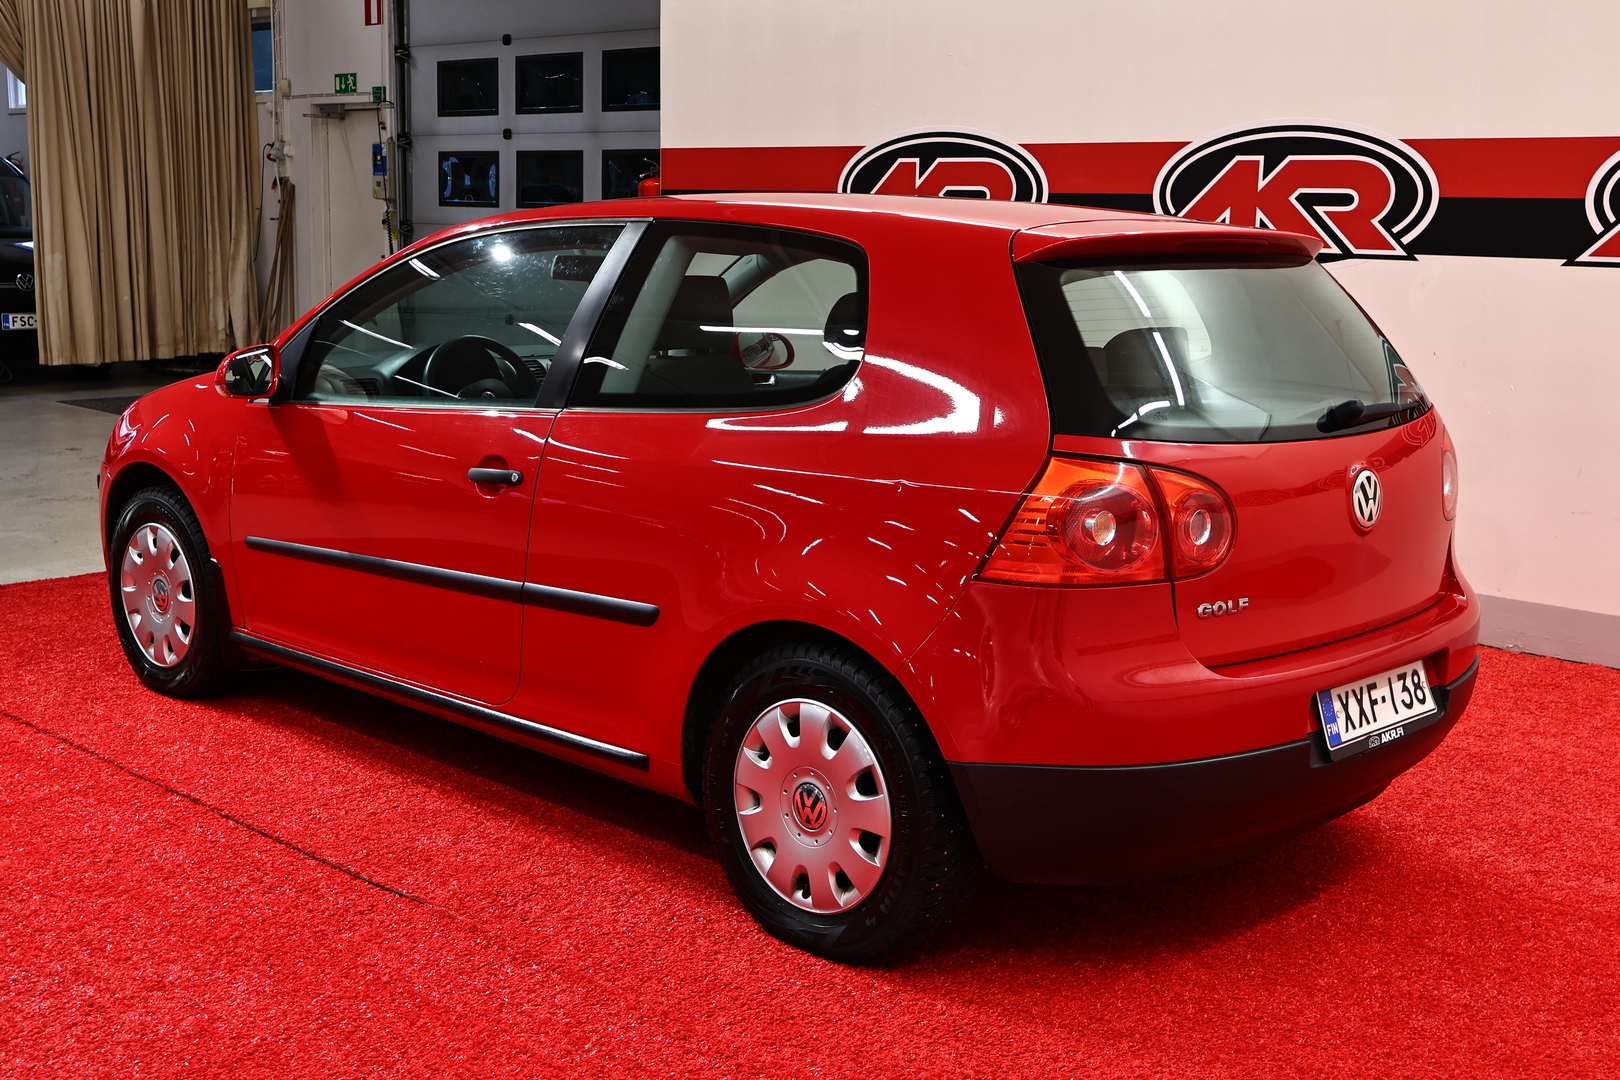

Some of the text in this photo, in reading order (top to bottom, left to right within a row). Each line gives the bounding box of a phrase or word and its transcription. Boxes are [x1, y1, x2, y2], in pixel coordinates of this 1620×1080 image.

[1196, 597, 1250, 620] GOLF
[1337, 669, 1426, 733] XXF-138
[1326, 721, 1340, 737] FIN
[1381, 726, 1405, 744] AKR.FI
